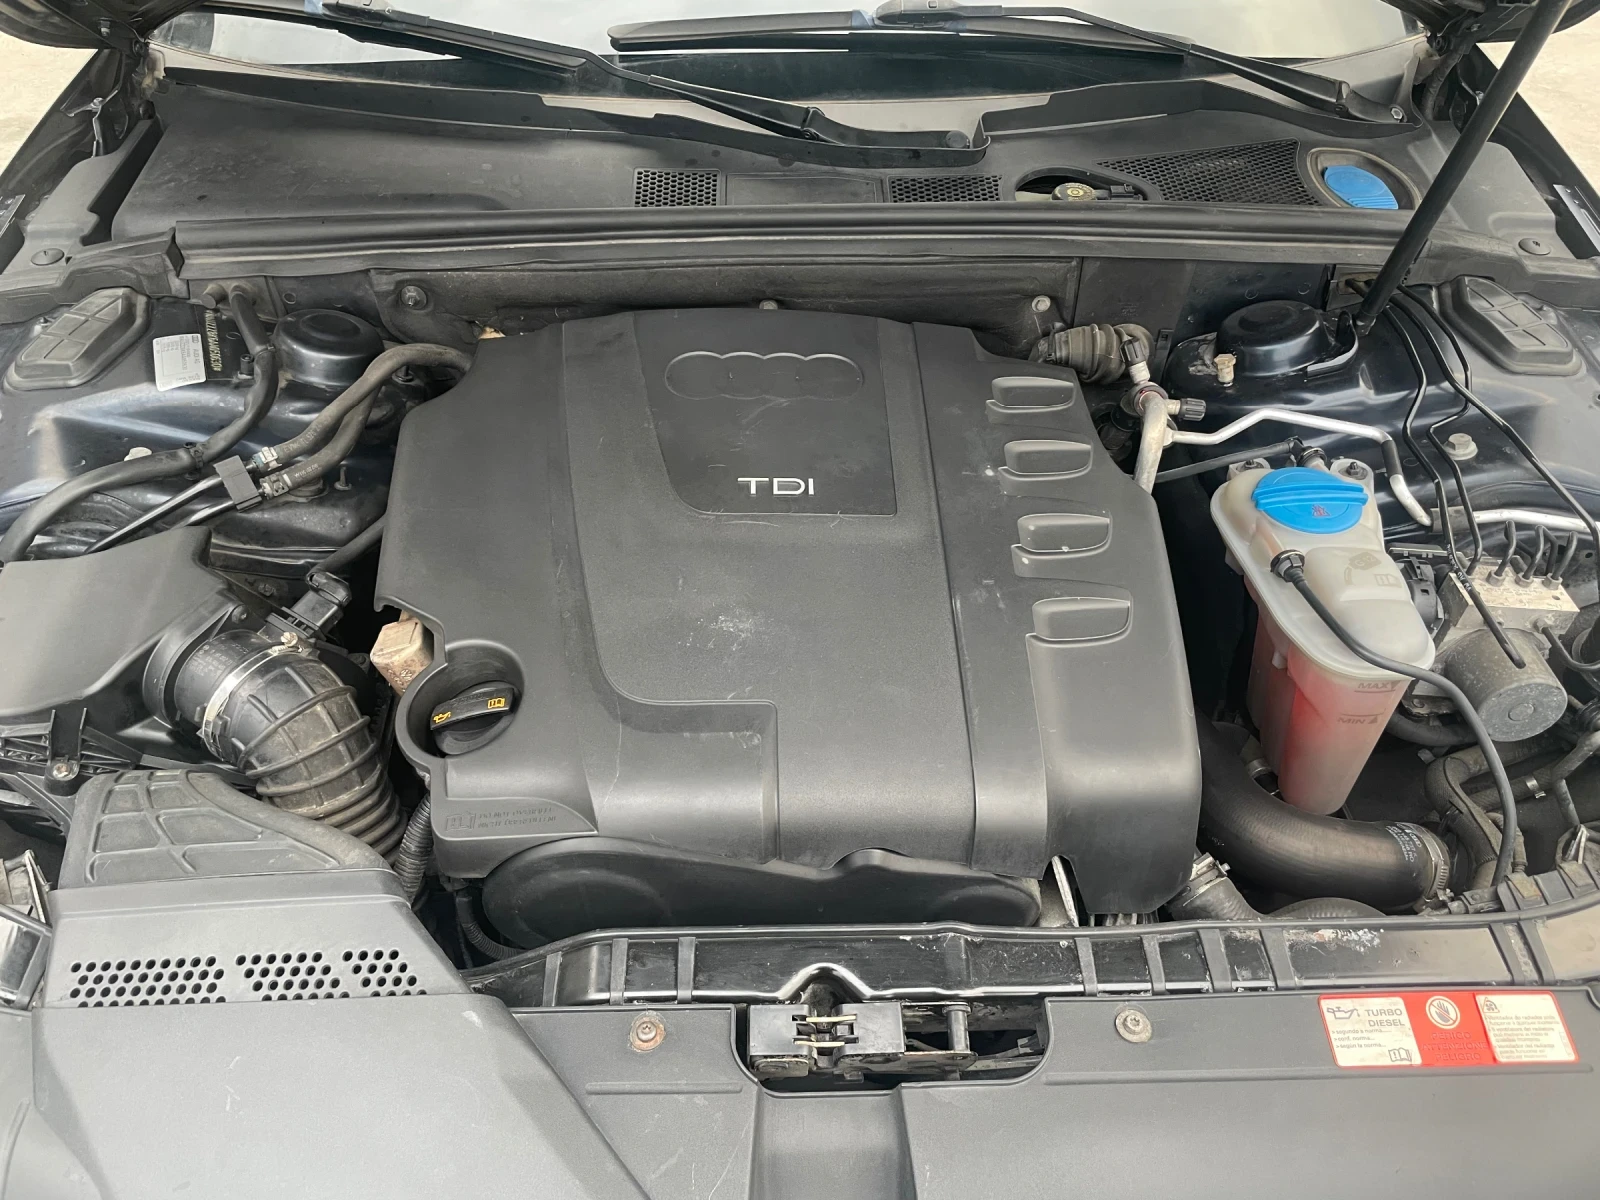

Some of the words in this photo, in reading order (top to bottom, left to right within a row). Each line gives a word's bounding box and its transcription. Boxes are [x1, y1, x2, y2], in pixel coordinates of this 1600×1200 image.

[737, 477, 815, 495] TDI
[1354, 555, 1376, 567] G12
[1357, 682, 1390, 690] MAX
[1336, 716, 1366, 725] MIN
[1364, 1008, 1403, 1017] TURBO
[1367, 1018, 1406, 1027] DIESEL
[1431, 1031, 1472, 1040] PERIGO
[1422, 1041, 1489, 1051] ATTENZIONE
[1434, 1052, 1481, 1061] PELIGRO
